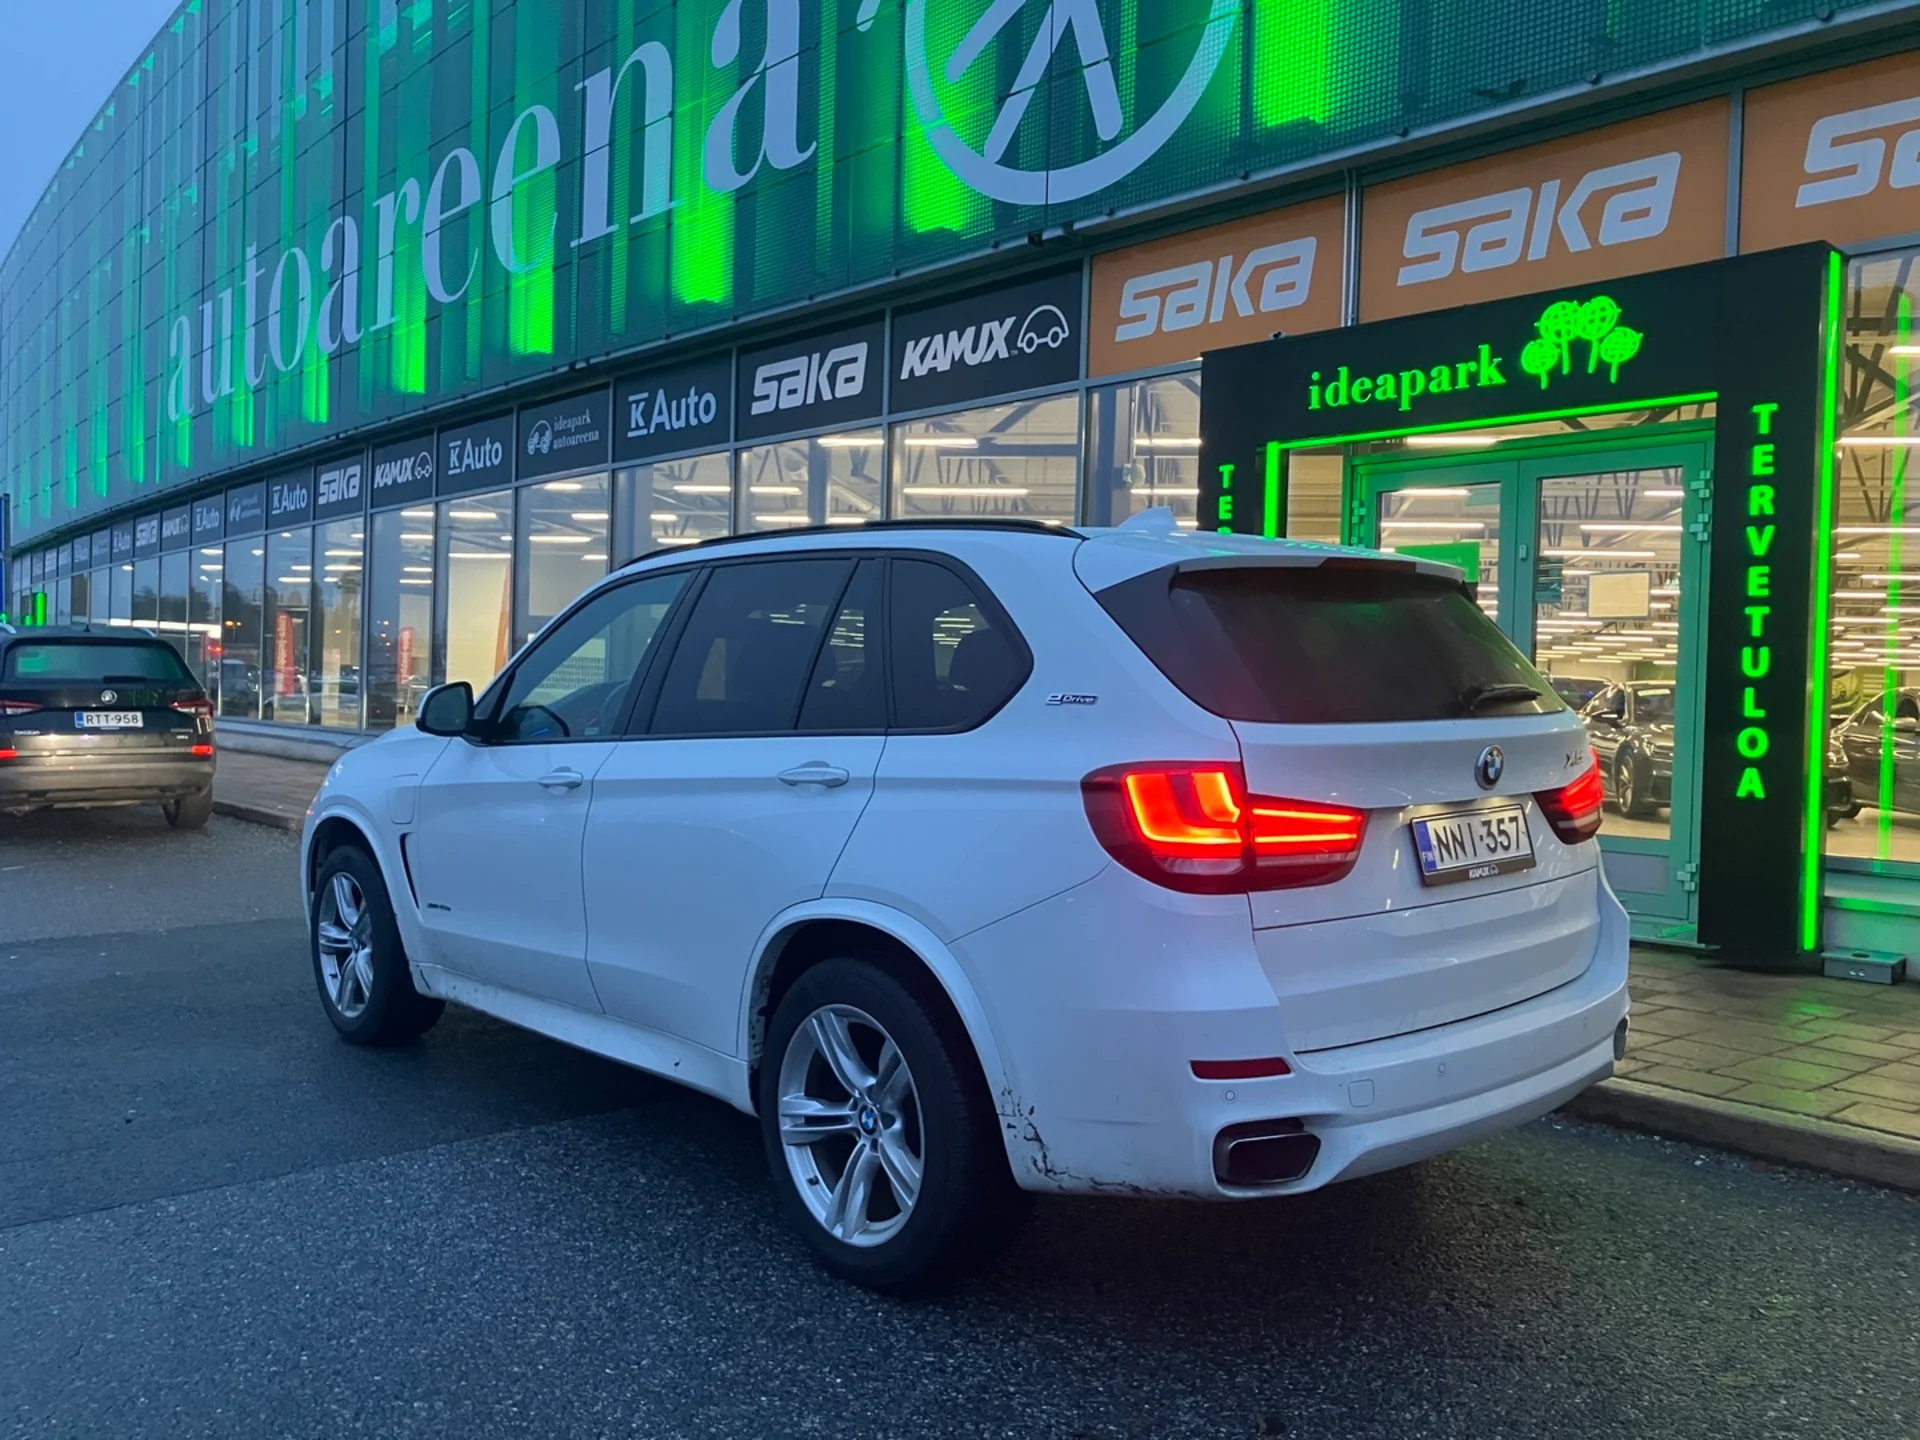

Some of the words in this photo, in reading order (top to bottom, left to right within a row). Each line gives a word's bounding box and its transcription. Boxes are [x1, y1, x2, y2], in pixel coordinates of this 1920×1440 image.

[167, 0, 817, 423] autoareena
[900, 316, 1016, 380] KAMUX
[1308, 344, 1507, 411] ideapark
[554, 409, 592, 433] ideapark
[374, 456, 416, 489] KAMUX
[1736, 403, 1778, 798] TERVETULOA
[86, 711, 139, 725] RTT-958
